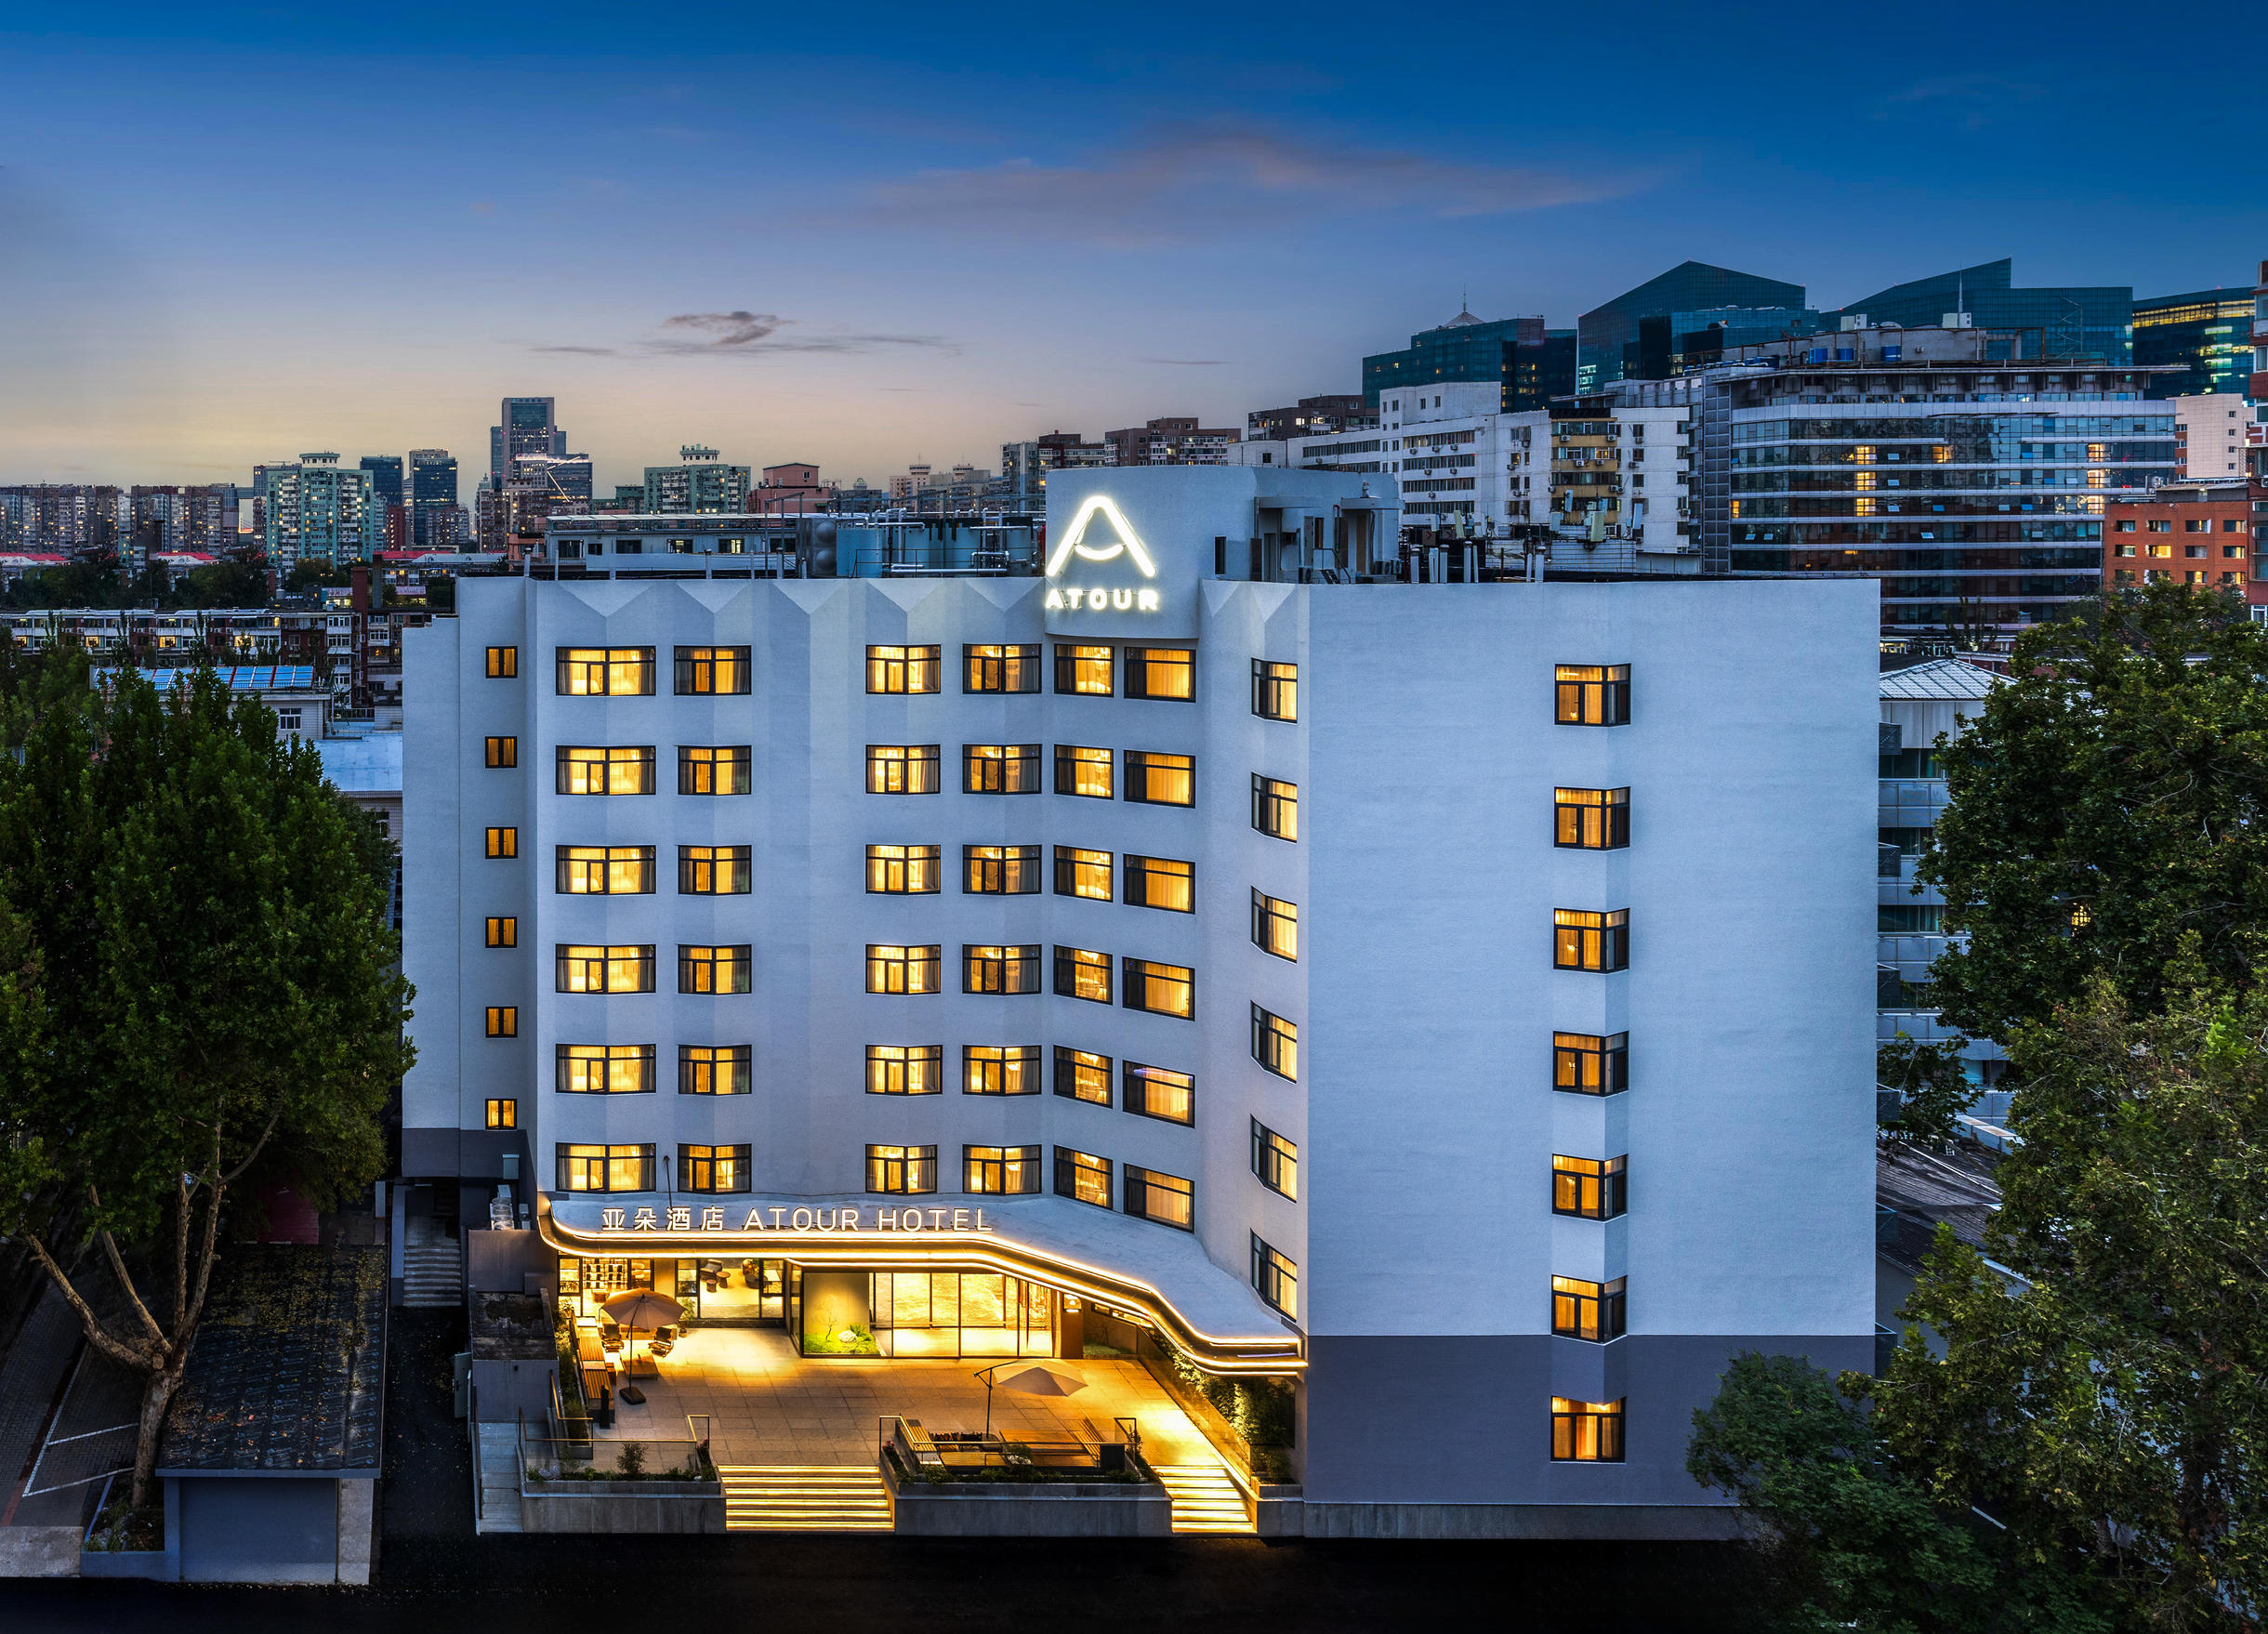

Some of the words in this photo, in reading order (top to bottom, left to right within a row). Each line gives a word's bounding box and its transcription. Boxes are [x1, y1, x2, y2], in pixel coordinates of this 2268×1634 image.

[1045, 588, 1159, 611] ATOUR
[601, 1206, 725, 1232] 亚朵酒店
[743, 1207, 860, 1232] ATOUR
[877, 1207, 993, 1232] HOTEL
